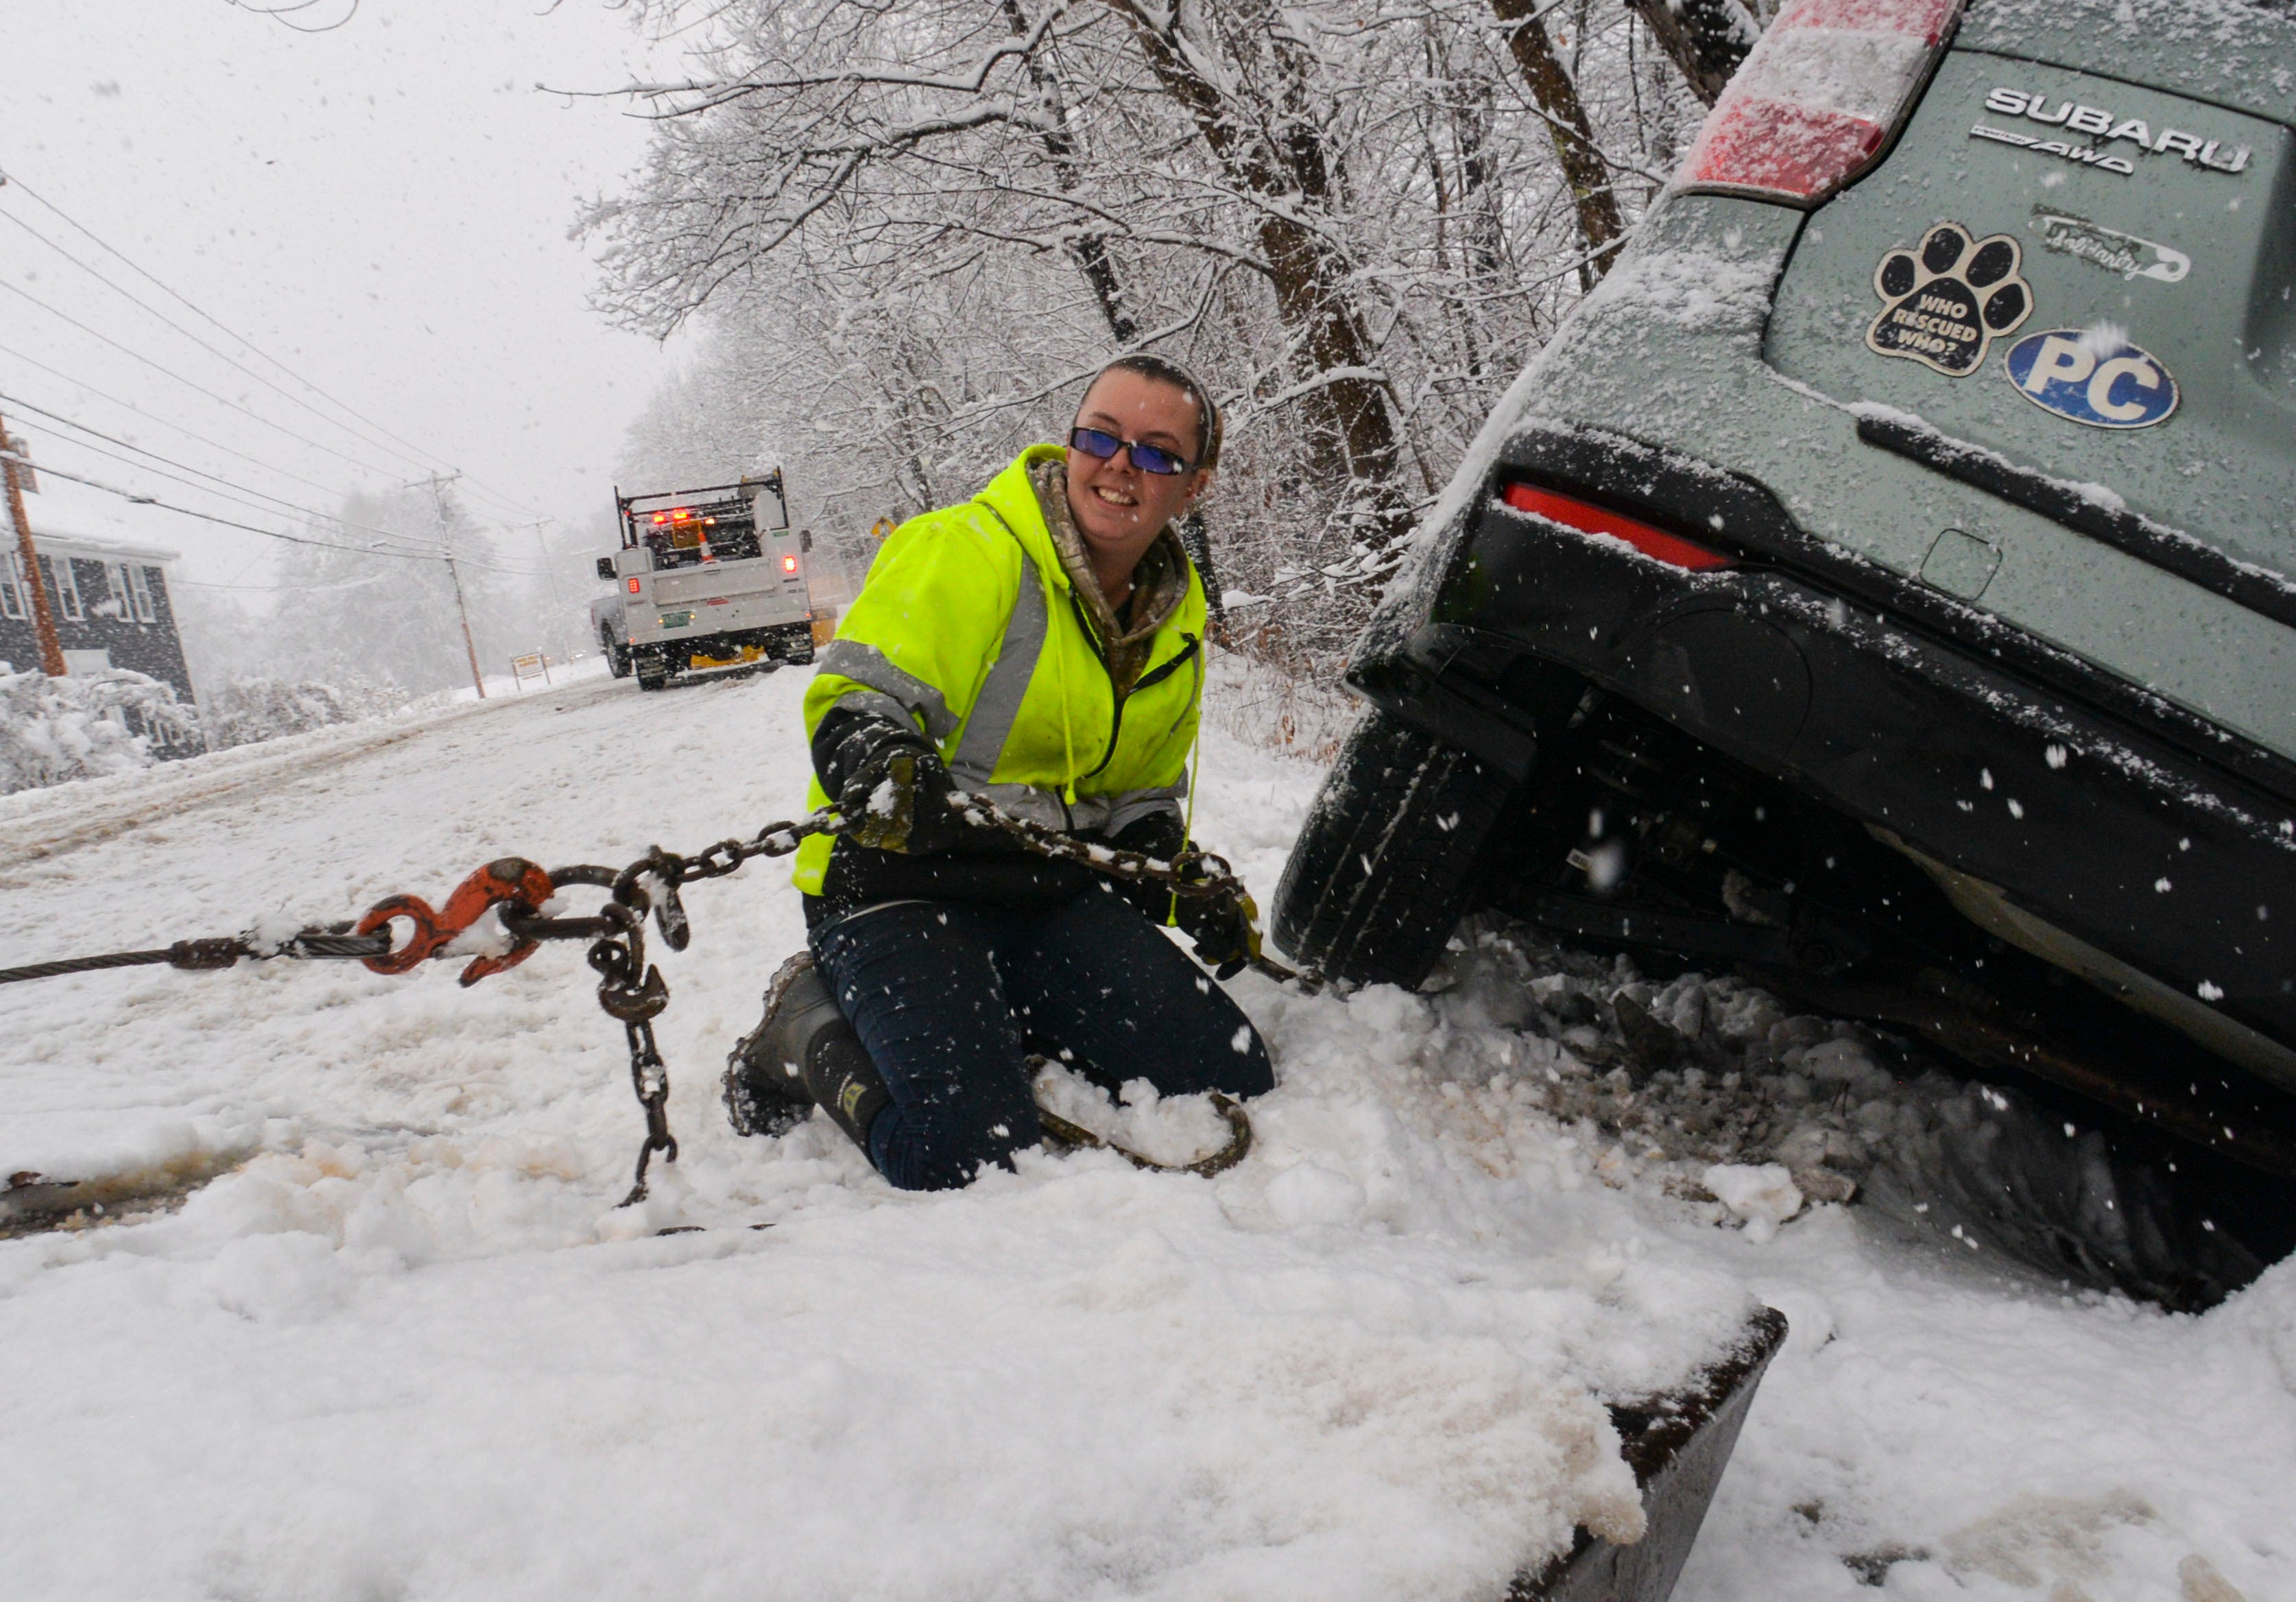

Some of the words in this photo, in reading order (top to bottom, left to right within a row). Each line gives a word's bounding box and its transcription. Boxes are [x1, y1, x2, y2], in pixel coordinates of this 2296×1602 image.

[1985, 87, 2252, 173] SUBARU
[2029, 139, 2134, 174] AWD
[2046, 228, 2142, 280] Solidarity
[1920, 294, 1968, 319] WHO
[1898, 329, 1959, 356] WHO?
[2023, 335, 2160, 421] PC
